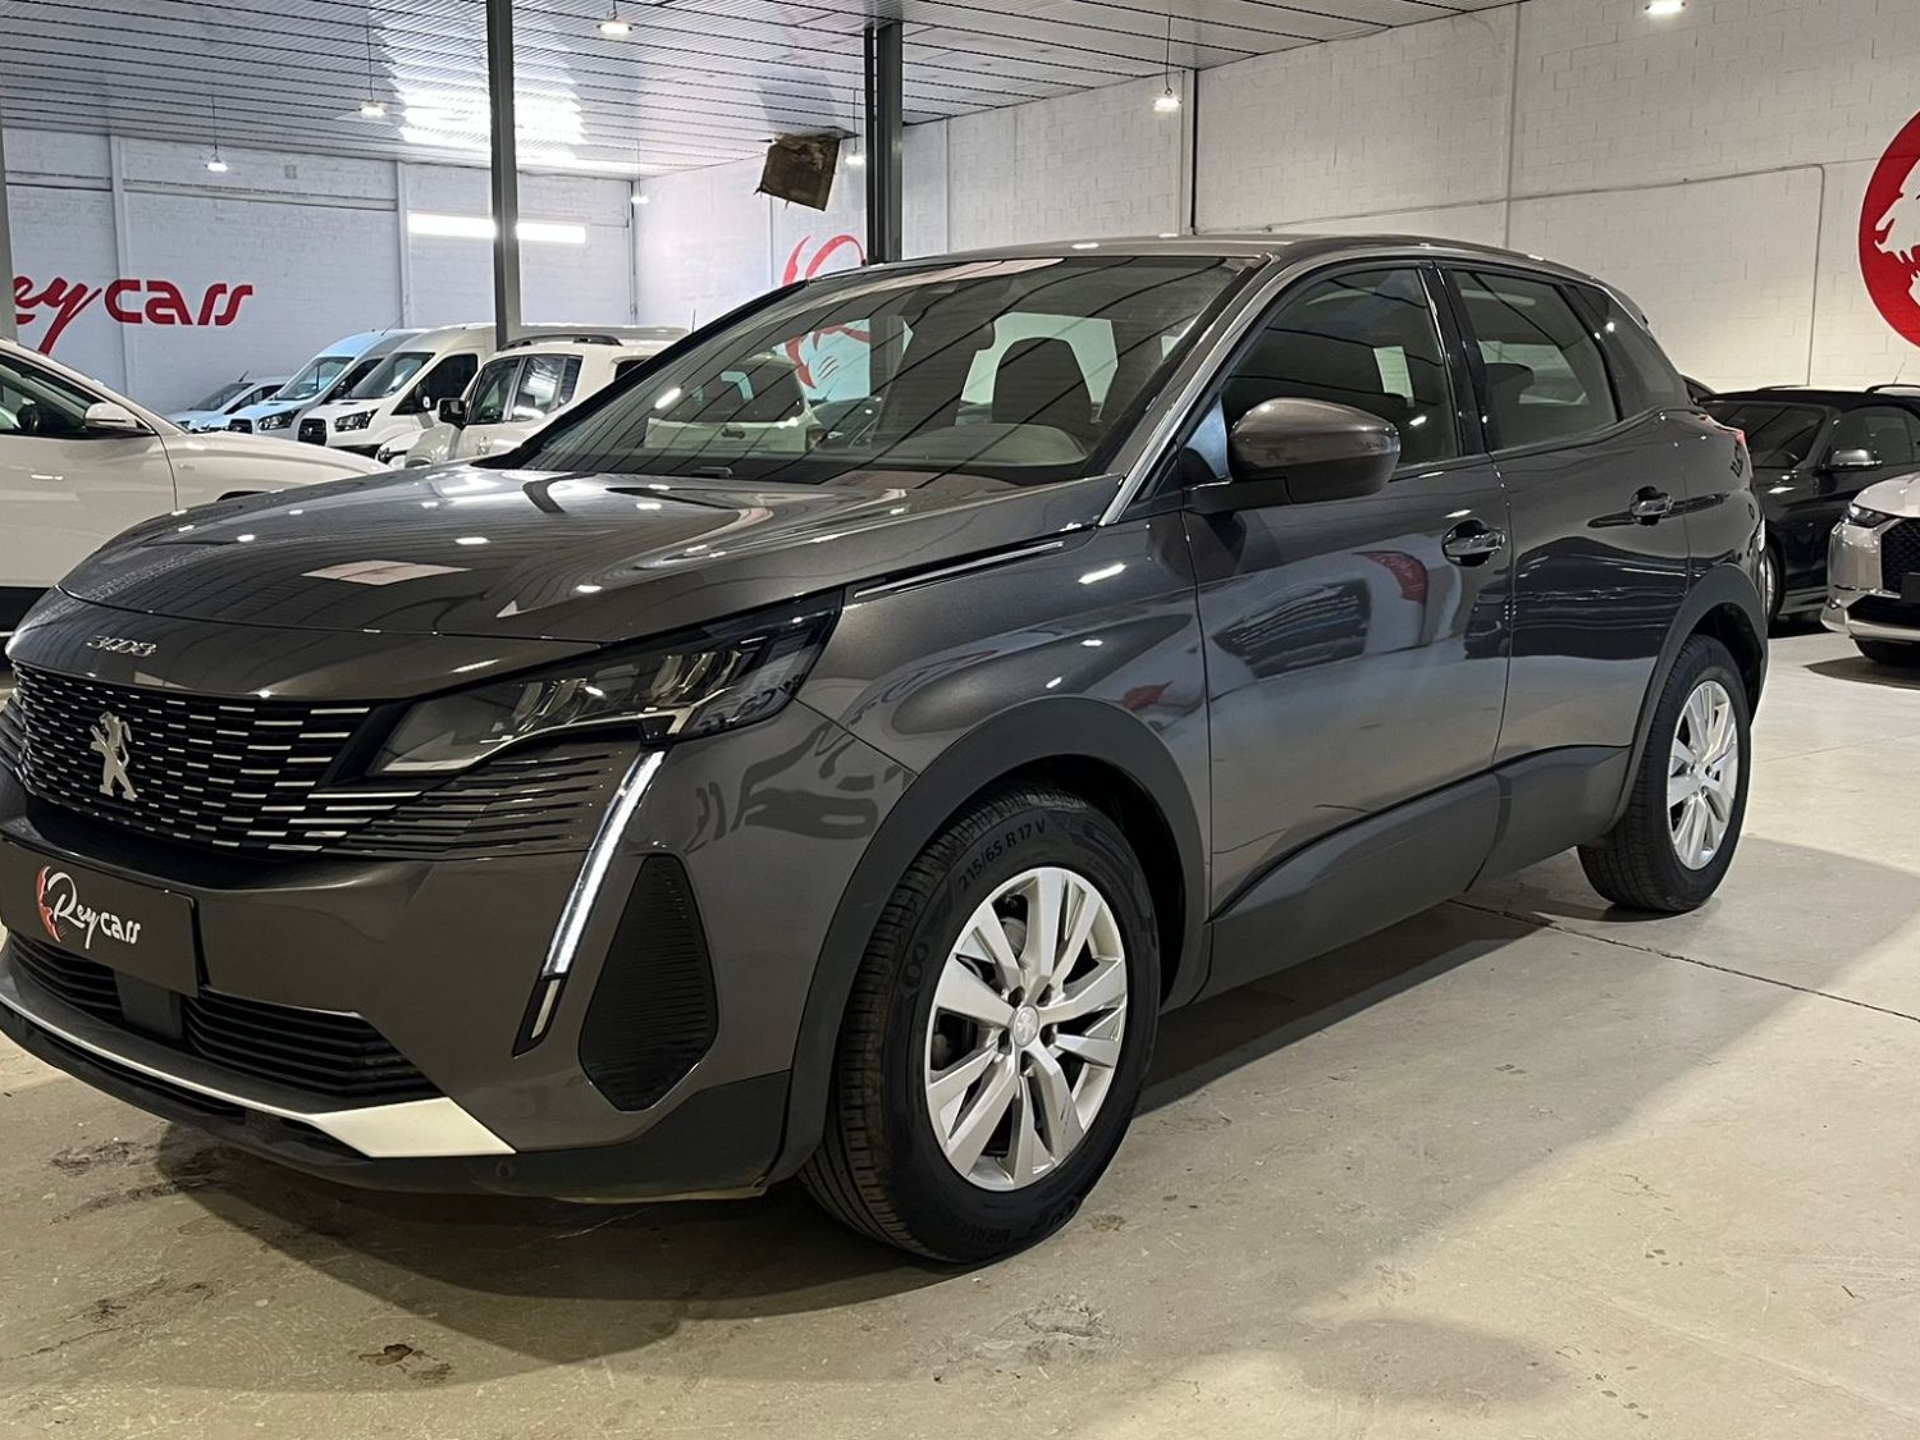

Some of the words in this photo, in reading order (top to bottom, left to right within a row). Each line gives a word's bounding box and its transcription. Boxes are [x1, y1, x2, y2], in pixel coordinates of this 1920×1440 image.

[13, 274, 253, 355] eycars
[87, 635, 157, 657] 3008
[958, 839, 1004, 892] 215/65
[1006, 833, 1017, 847] R
[1019, 824, 1032, 841] 17
[1035, 819, 1046, 834] V
